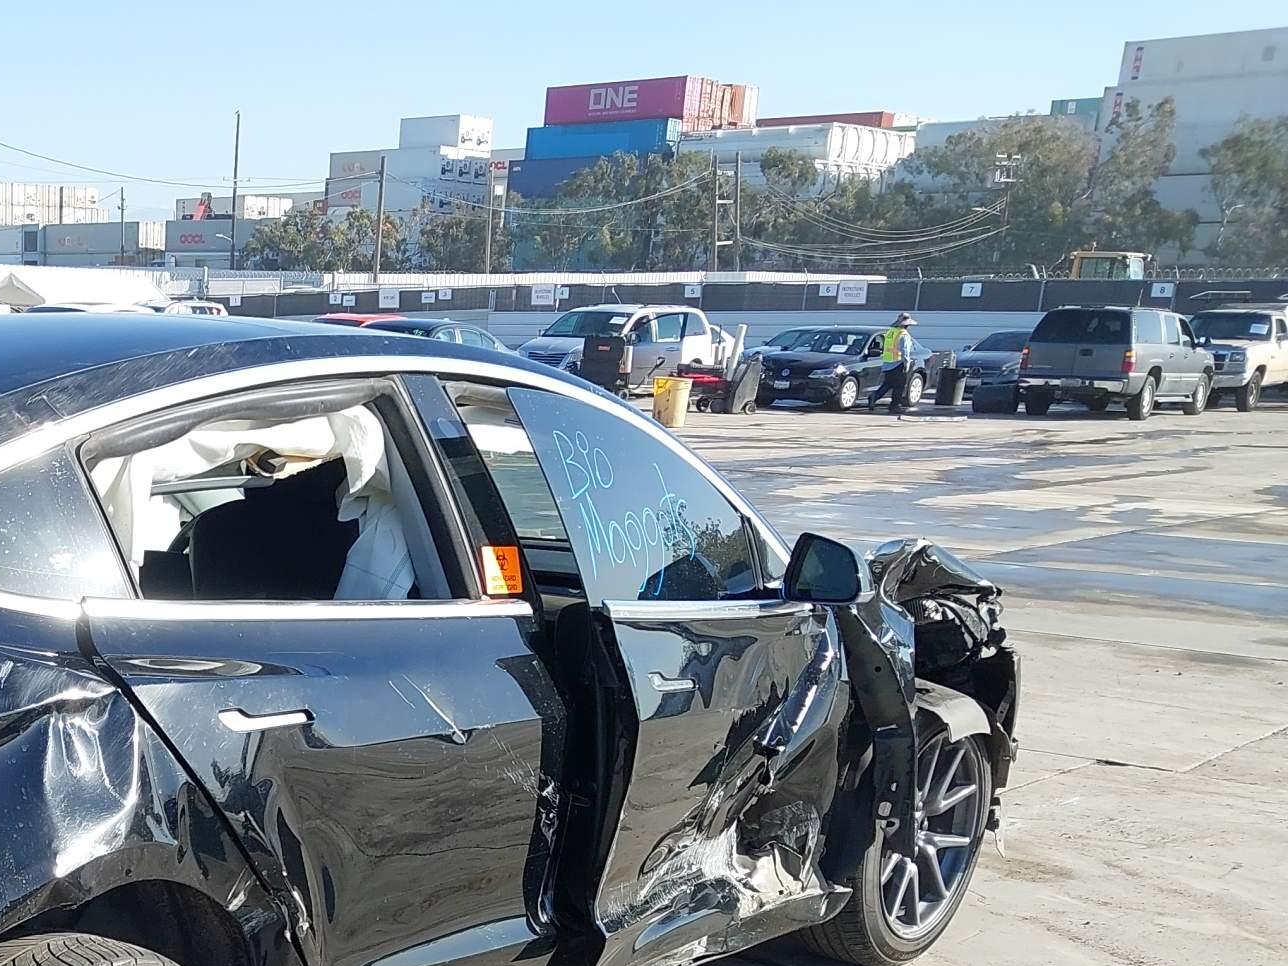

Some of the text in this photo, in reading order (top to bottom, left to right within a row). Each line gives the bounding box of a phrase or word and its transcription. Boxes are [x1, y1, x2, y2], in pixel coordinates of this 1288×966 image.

[589, 86, 639, 110] ONE
[179, 233, 205, 245] OOCL
[553, 430, 614, 499] Bio
[580, 463, 696, 596] Maggots
